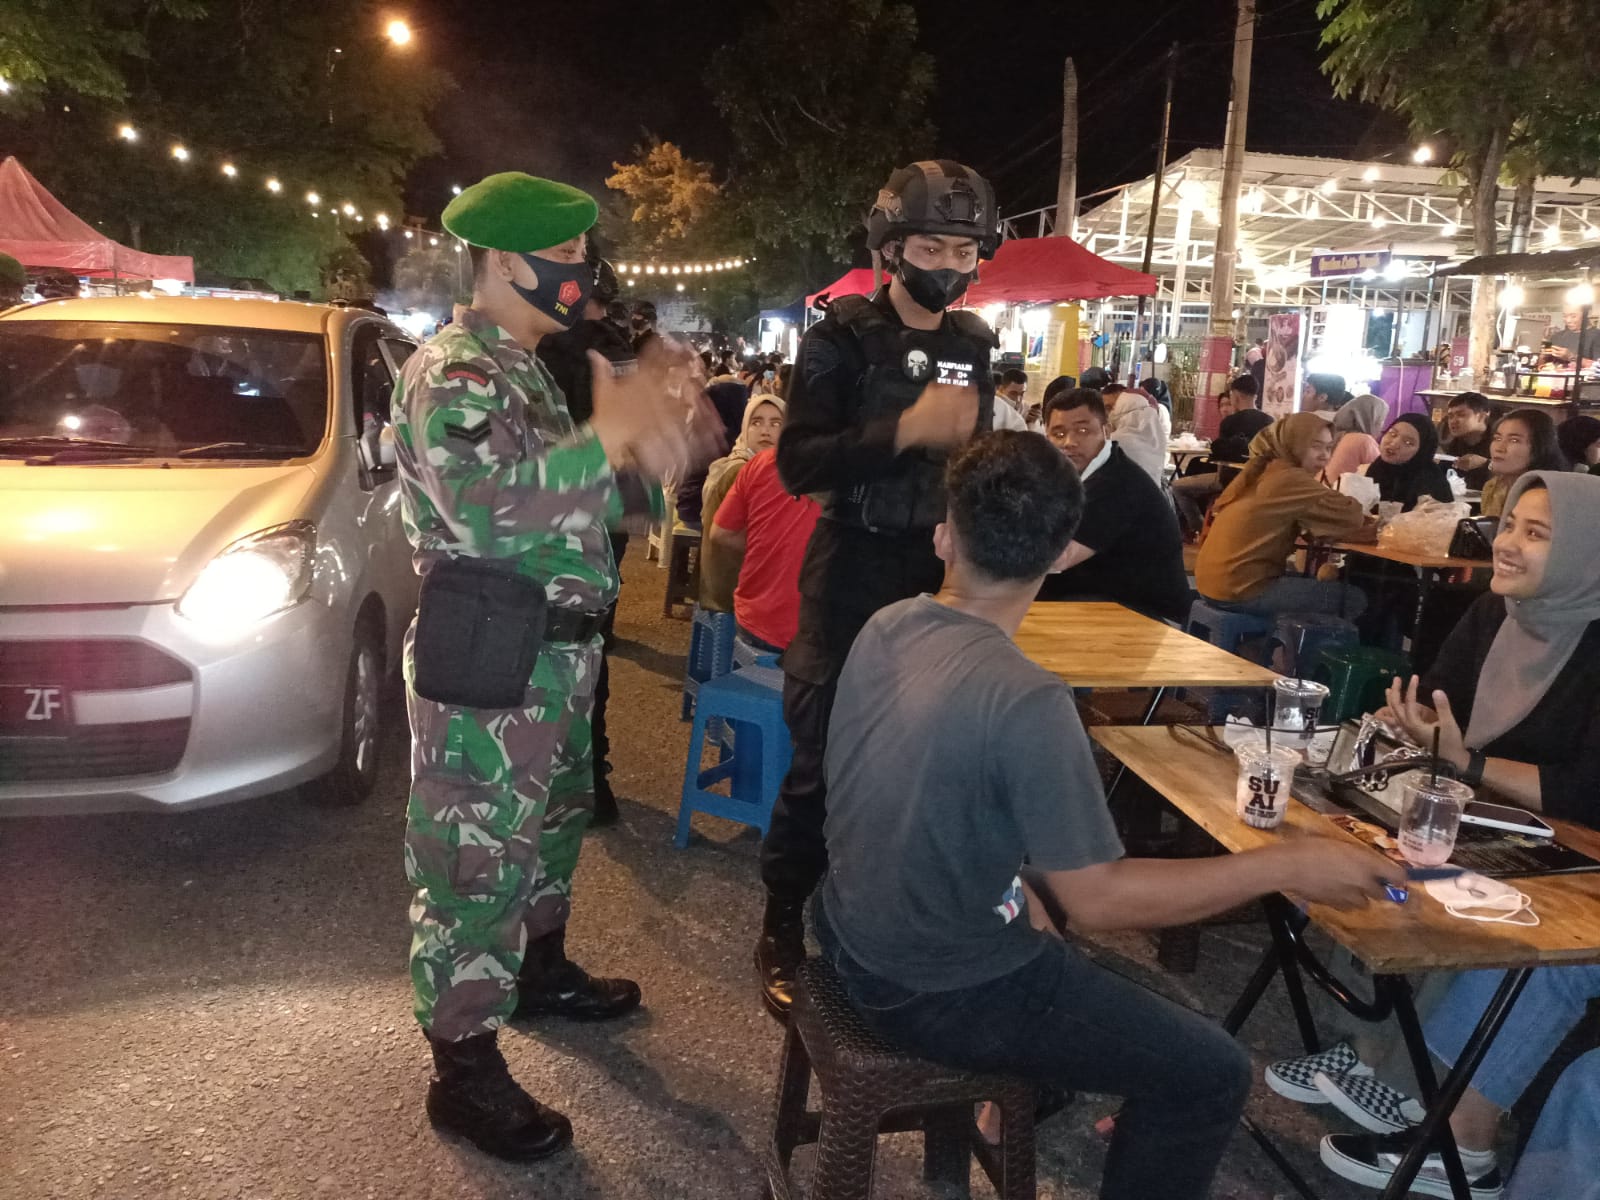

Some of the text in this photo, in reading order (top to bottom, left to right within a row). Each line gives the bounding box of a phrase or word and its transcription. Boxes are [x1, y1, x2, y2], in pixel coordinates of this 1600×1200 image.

[554, 301, 569, 316] TNI
[24, 688, 60, 720] ZF
[1248, 775, 1280, 795] SU
[1248, 792, 1276, 811] AI
